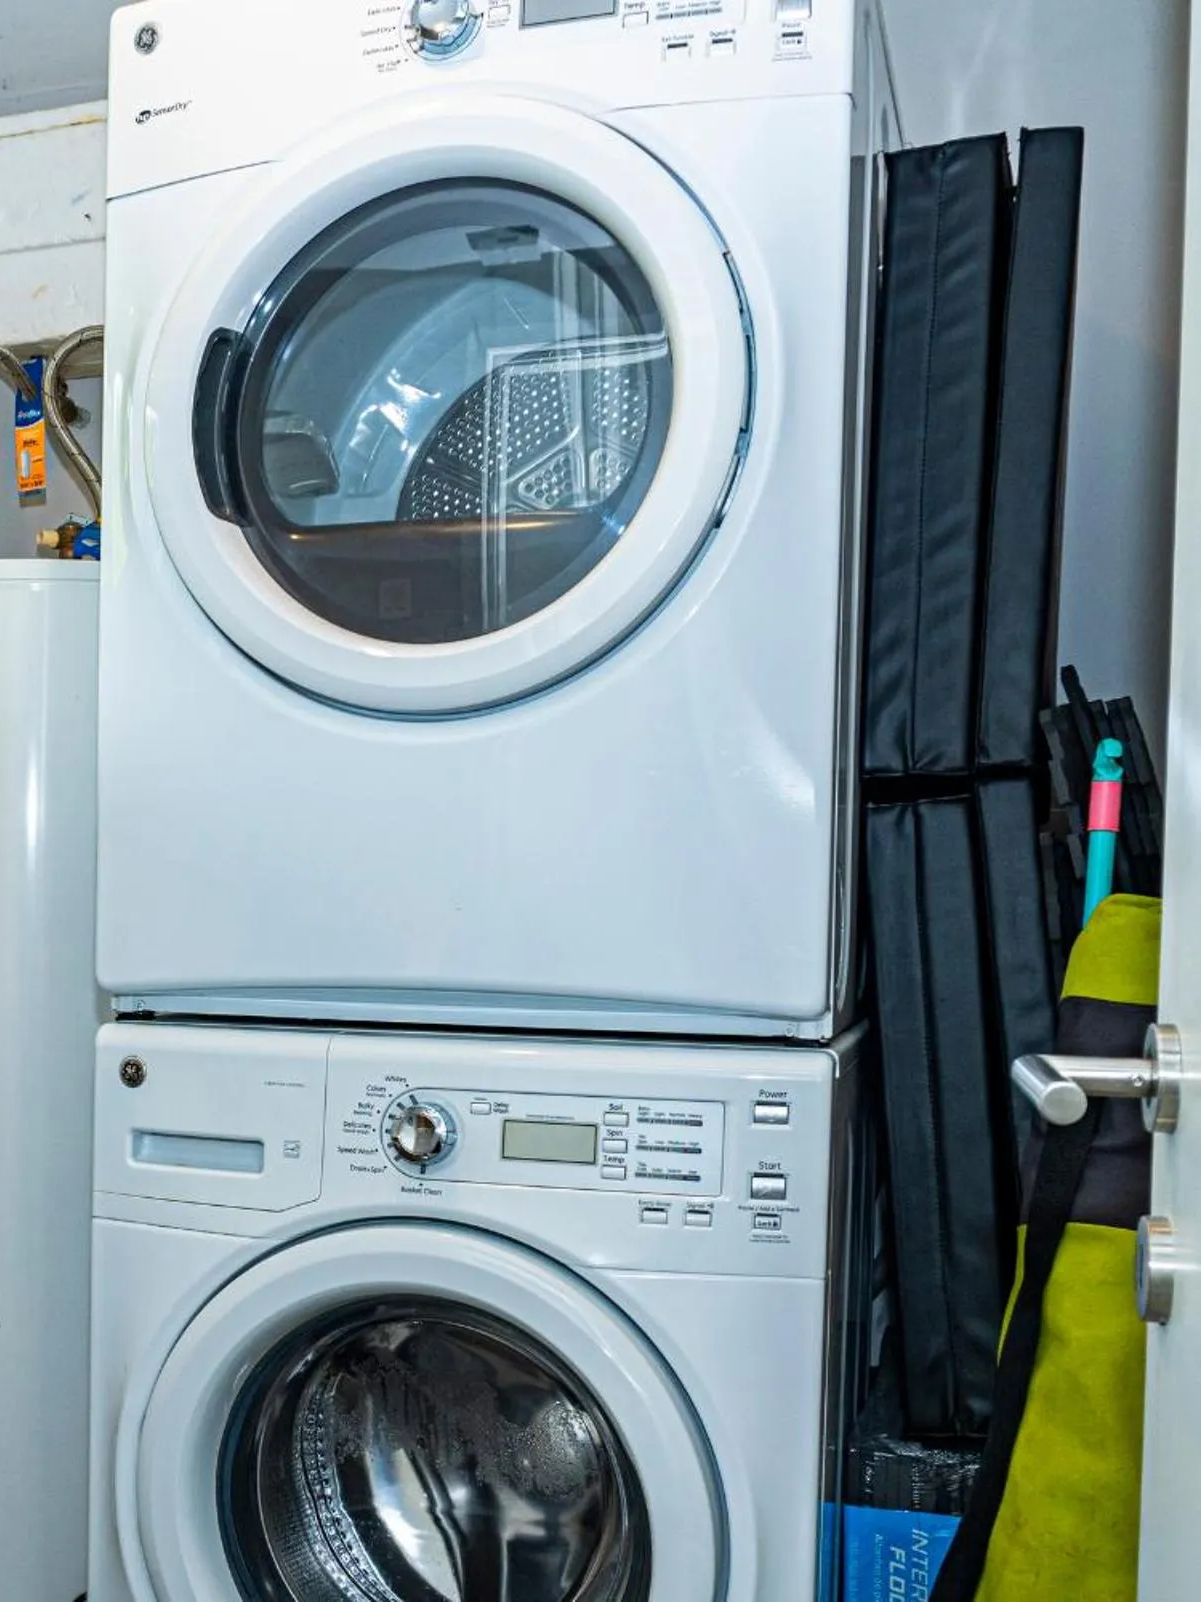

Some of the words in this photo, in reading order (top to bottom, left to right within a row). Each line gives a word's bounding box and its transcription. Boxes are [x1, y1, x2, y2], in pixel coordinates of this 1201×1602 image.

[759, 1089, 788, 1098] Power
[609, 1103, 623, 1111] Soil
[606, 1128, 624, 1137] Spin
[604, 1155, 625, 1164] Temp
[758, 1160, 781, 1170] Start
